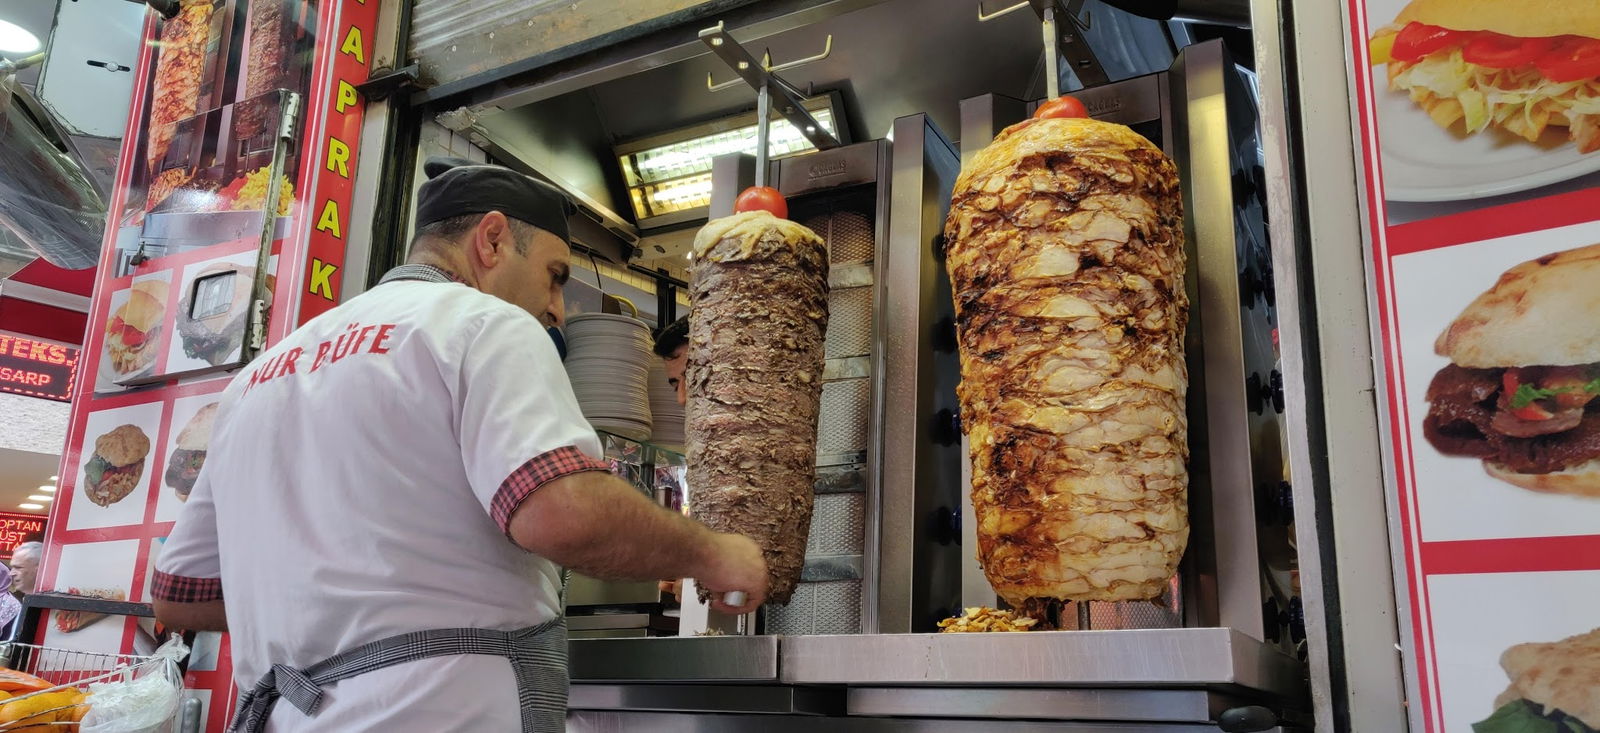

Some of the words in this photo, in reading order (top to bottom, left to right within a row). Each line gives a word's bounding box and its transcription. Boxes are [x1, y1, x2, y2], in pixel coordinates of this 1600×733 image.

[309, 0, 365, 301] APRAK
[0, 367, 51, 386] SARP
[242, 346, 304, 399] NUR
[308, 322, 396, 374] BÜFE
